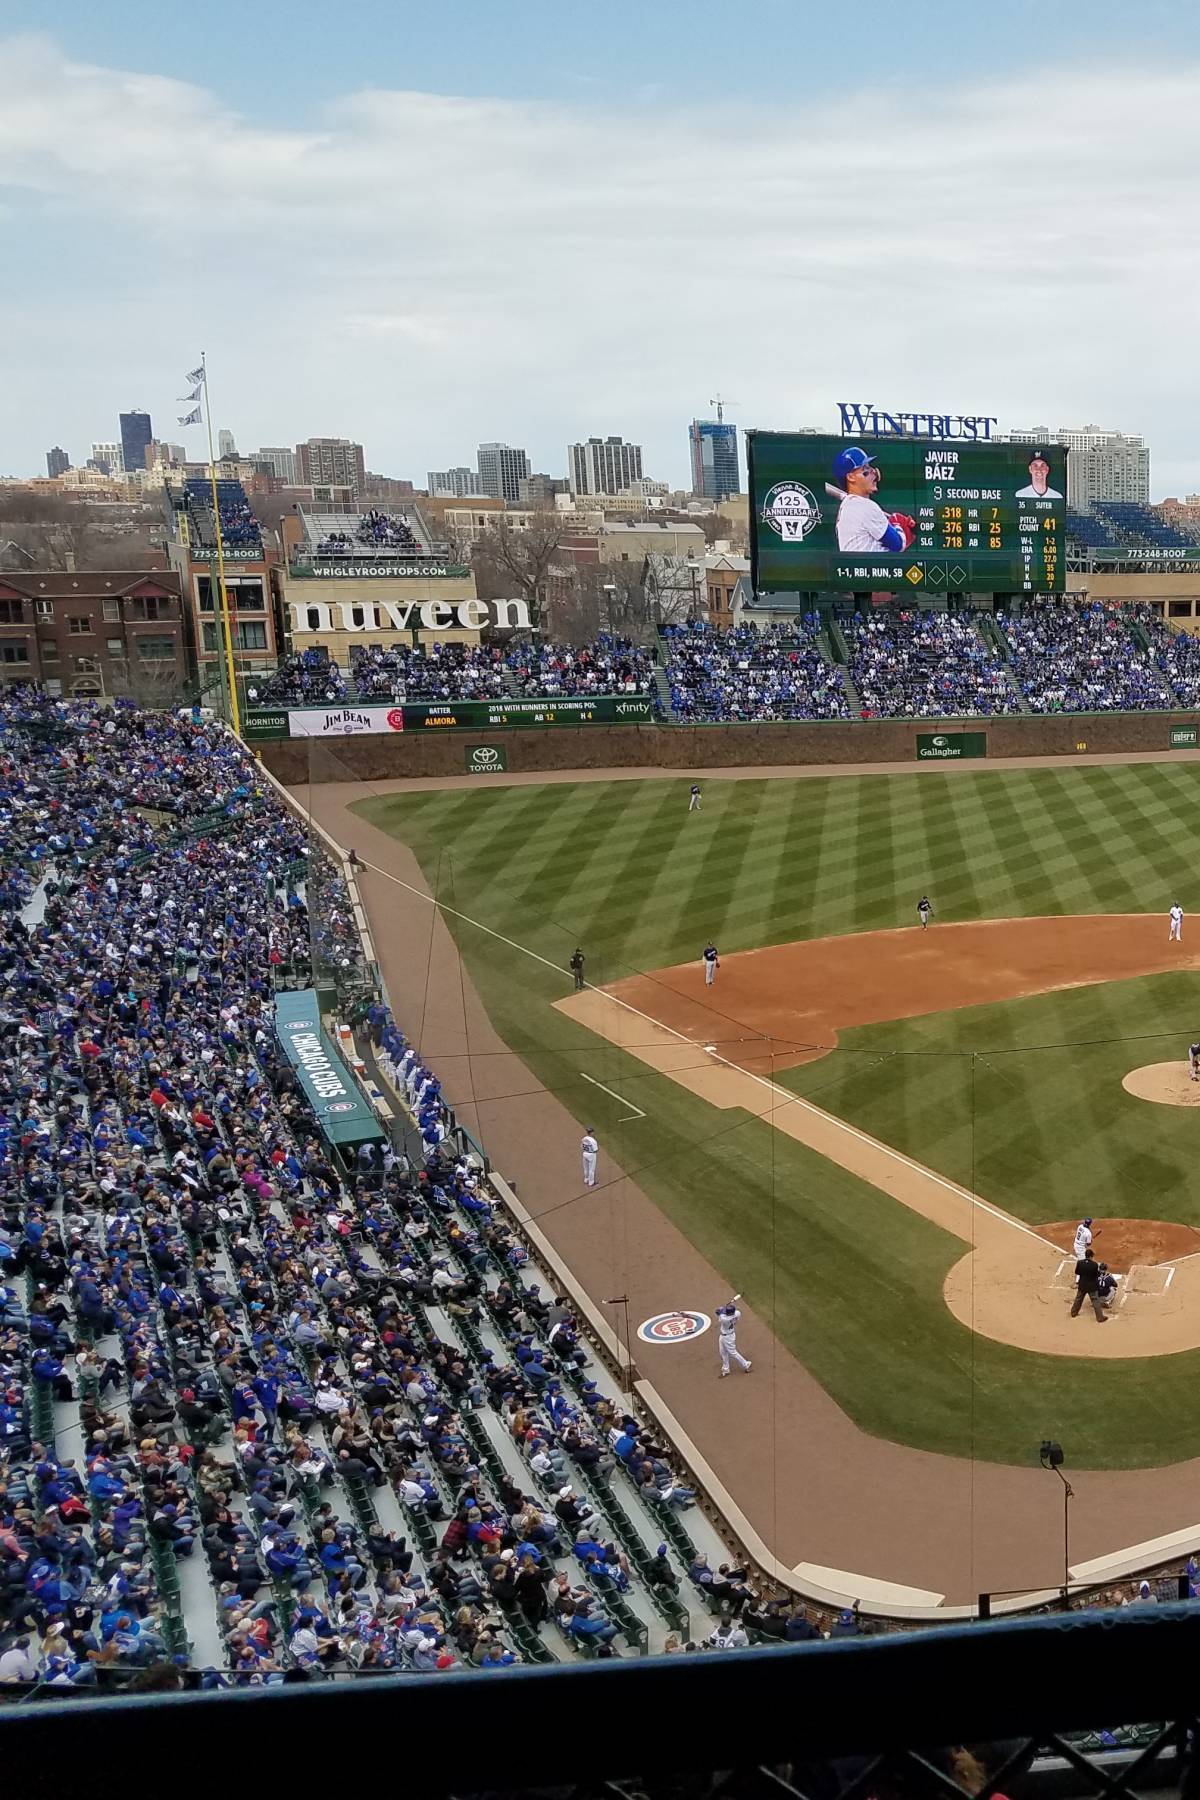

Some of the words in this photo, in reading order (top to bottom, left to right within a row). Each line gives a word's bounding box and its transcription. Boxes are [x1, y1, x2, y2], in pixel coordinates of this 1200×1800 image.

[836, 403, 997, 439] WINTRUST
[925, 451, 959, 463] JAVIER
[925, 463, 955, 480] BÁEZ
[947, 488, 979, 499] SECOND
[982, 489, 1001, 499] BASE
[778, 497, 800, 506] 125
[1018, 501, 1025, 509] 35
[766, 508, 816, 516] ANNIVERSARY
[920, 508, 934, 516] AVG
[942, 507, 961, 518] .318
[968, 509, 978, 517] HR
[991, 508, 998, 518] 7
[920, 523, 934, 531] OBP
[942, 522, 962, 533] .376
[969, 523, 980, 532] RBI
[990, 523, 1001, 533] 25
[1043, 518, 1056, 530] 41
[921, 538, 933, 546] SLG
[943, 537, 962, 547] .718
[990, 538, 1001, 548] 85
[1127, 550, 1187, 558] 773-248-ROOF
[313, 567, 447, 577] WRIGLEYROOFTOPS.COM
[837, 568, 852, 578] 1-1,
[854, 568, 870, 578] RBI,
[872, 568, 891, 578] RUN,
[893, 569, 903, 577] SB
[289, 598, 533, 632] nuveen
[616, 702, 649, 714] xfinity
[246, 717, 286, 726] HORNITOS
[323, 714, 341, 731] JIM
[343, 710, 371, 729] BEAM
[425, 717, 456, 725] ALMORA
[920, 748, 961, 756] Gallagher
[469, 763, 503, 772] TOYOTA
[290, 1032, 331, 1071] CHICAGO
[309, 1070, 347, 1098] CUBS
